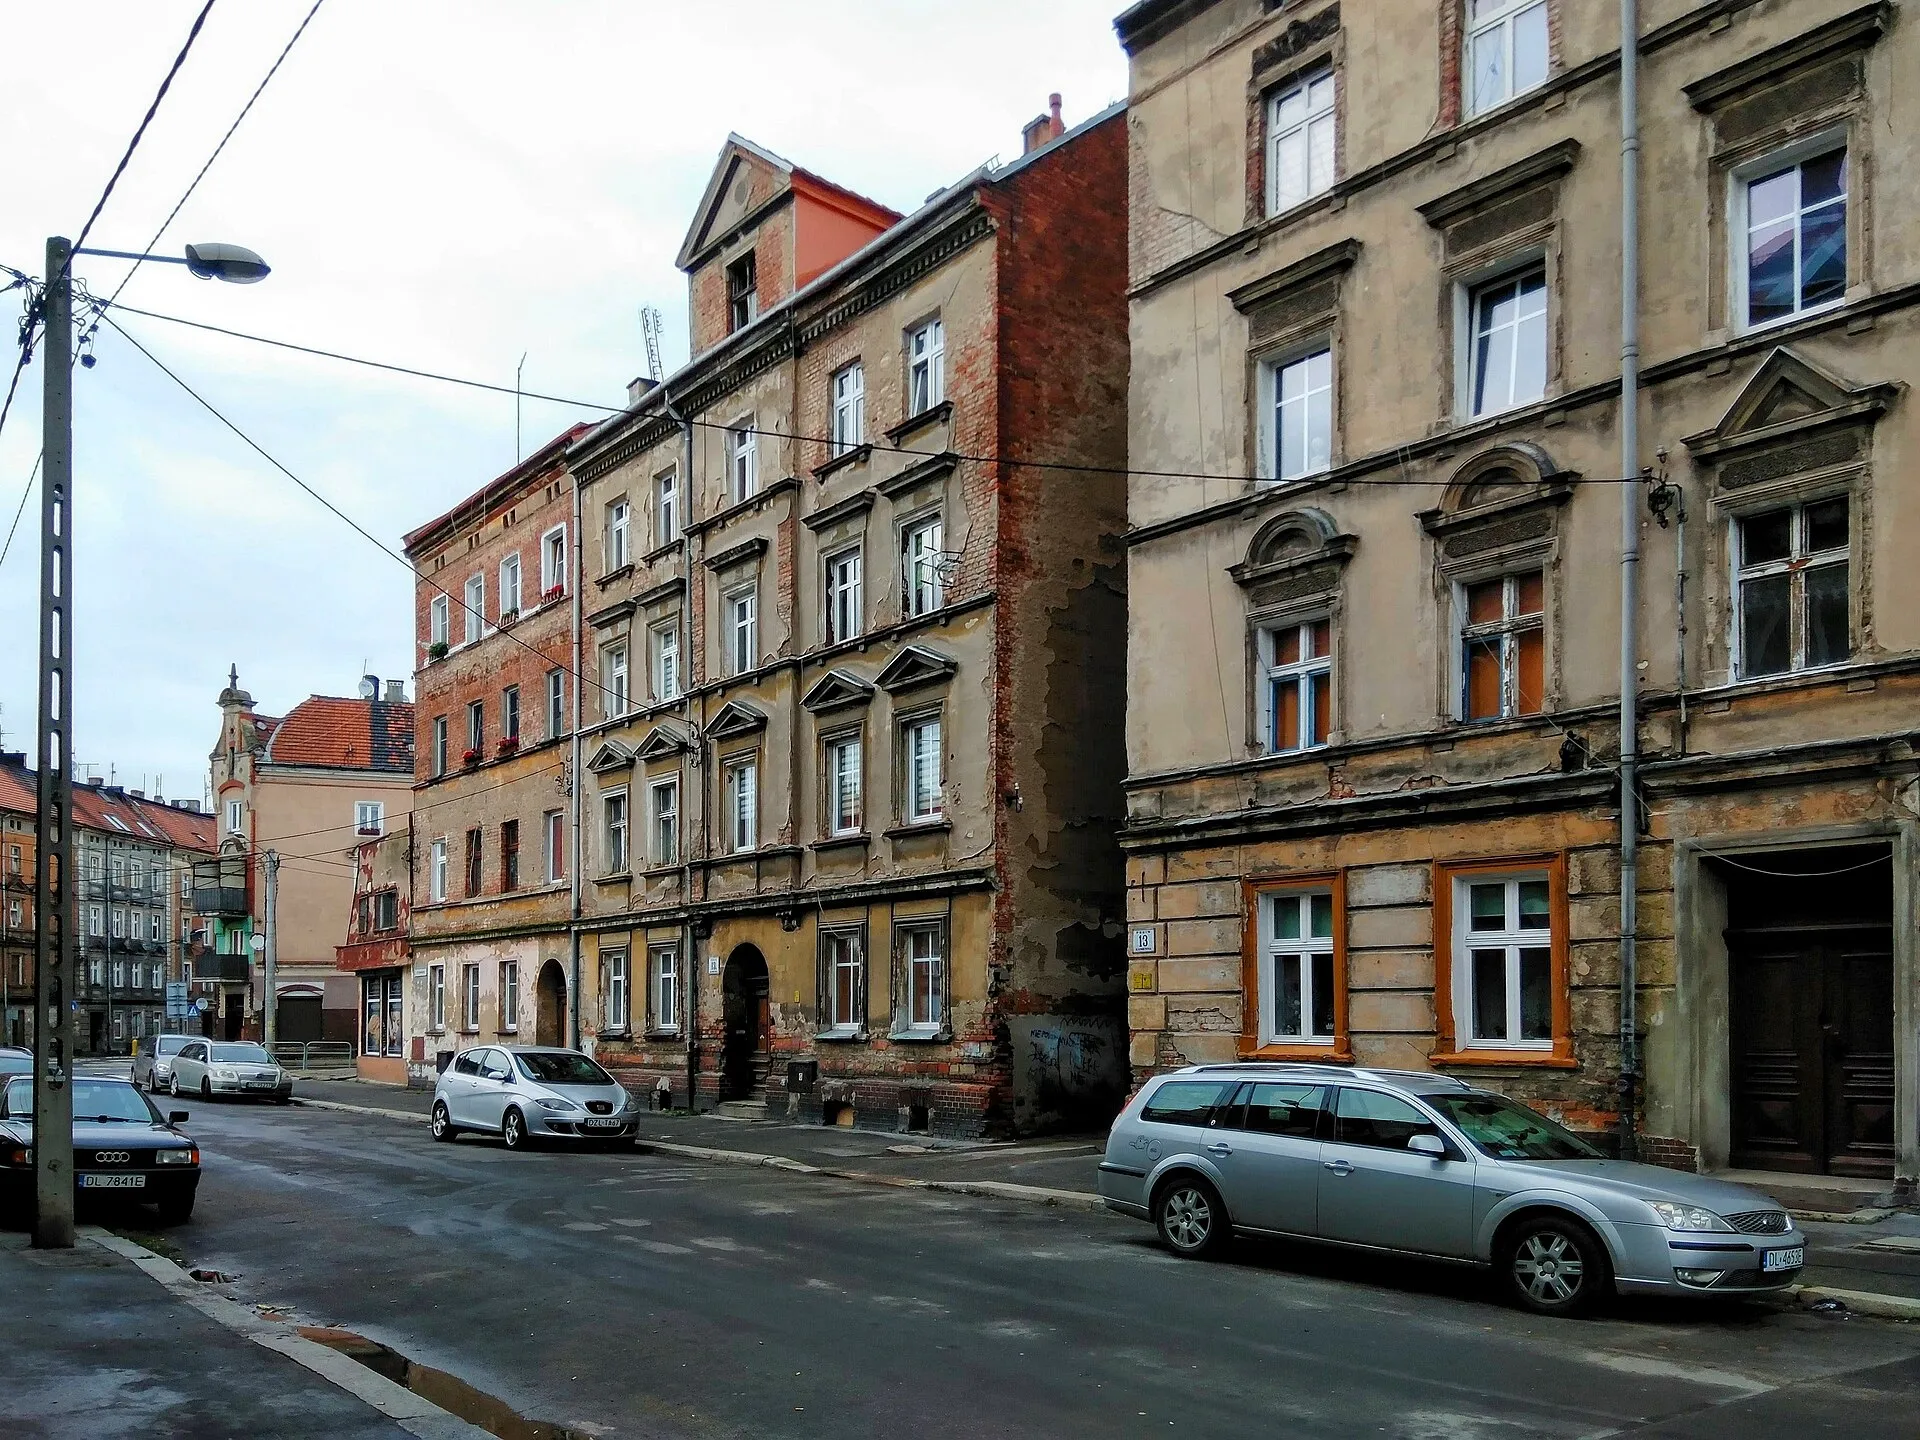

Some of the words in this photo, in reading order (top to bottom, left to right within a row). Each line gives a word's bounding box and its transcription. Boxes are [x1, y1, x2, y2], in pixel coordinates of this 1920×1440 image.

[1138, 934, 1148, 948] 13
[86, 1176, 101, 1187] DL
[106, 1176, 144, 1187] 7841E
[1769, 1252, 1780, 1267] DL
